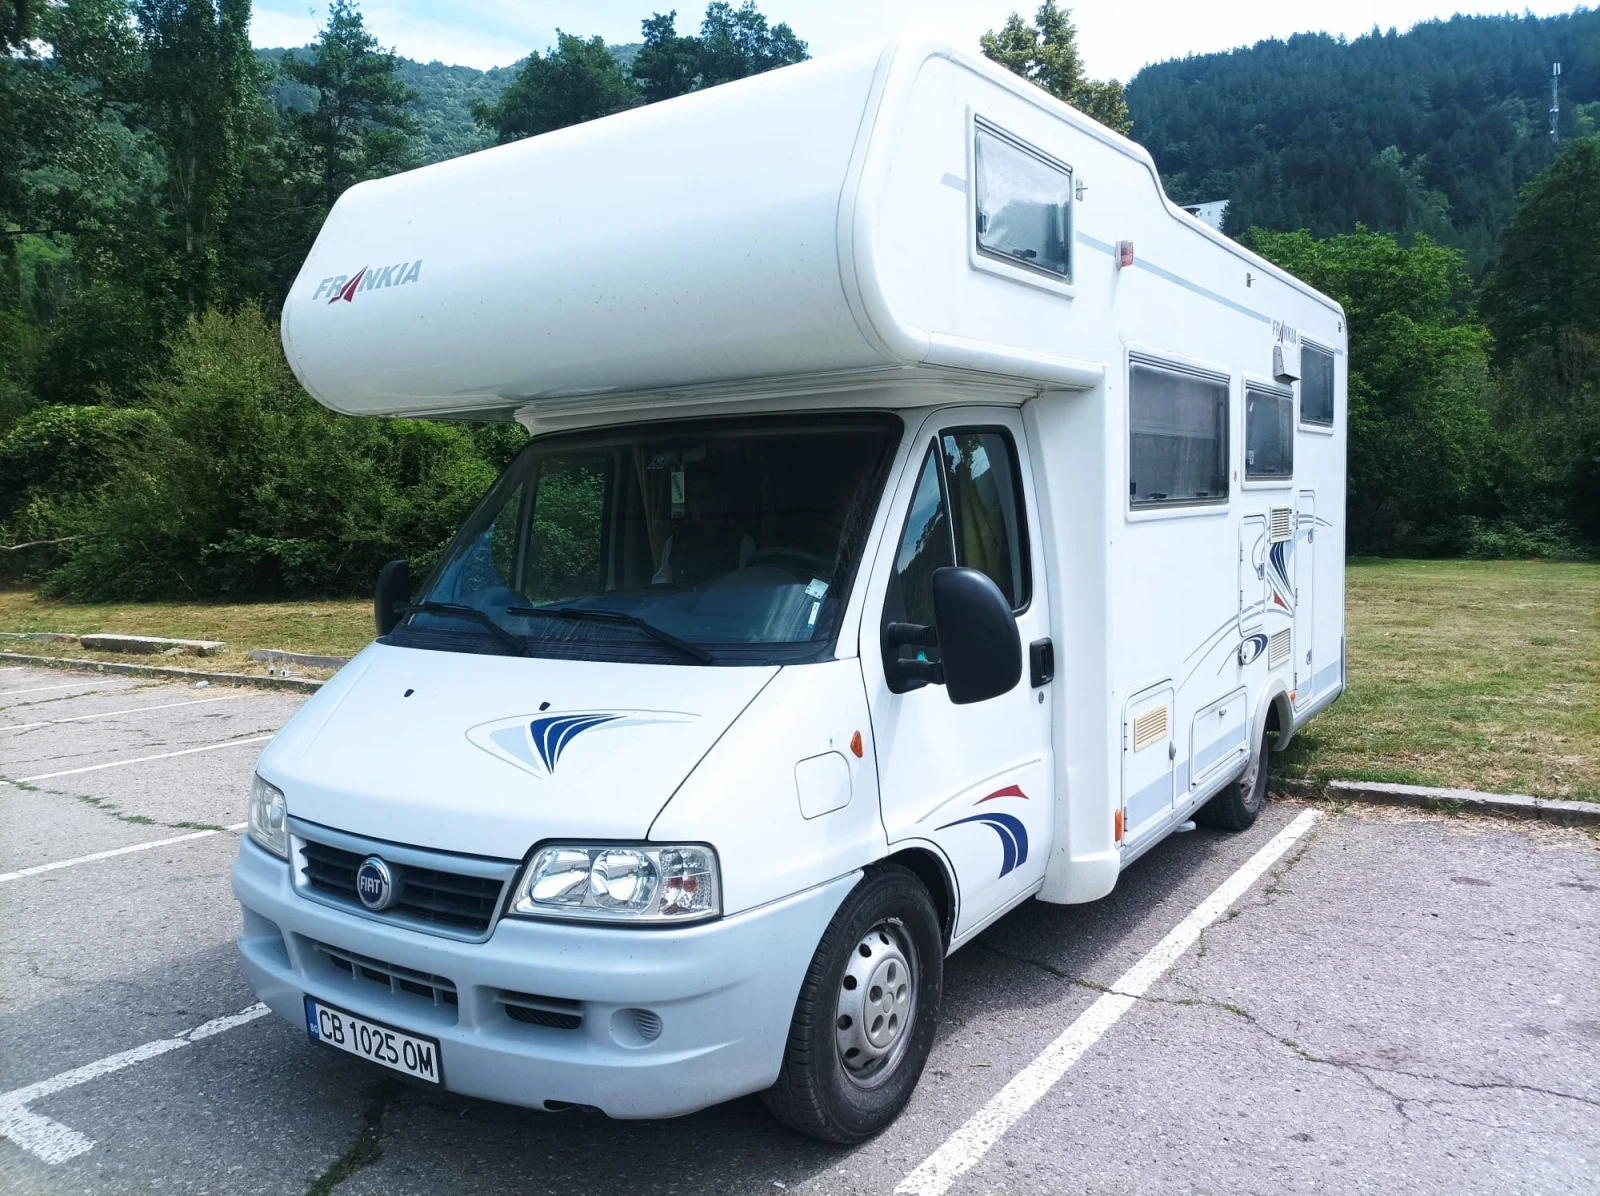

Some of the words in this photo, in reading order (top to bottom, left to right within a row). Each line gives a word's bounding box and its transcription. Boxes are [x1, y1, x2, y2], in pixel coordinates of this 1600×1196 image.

[312, 260, 422, 304] FRANKIA
[1272, 319, 1297, 345] FRANKIA
[360, 876, 380, 894] FIAT
[310, 1023, 319, 1034] BG
[319, 1010, 345, 1044] CB
[350, 1021, 399, 1064] 1025
[403, 1040, 434, 1077] OM
